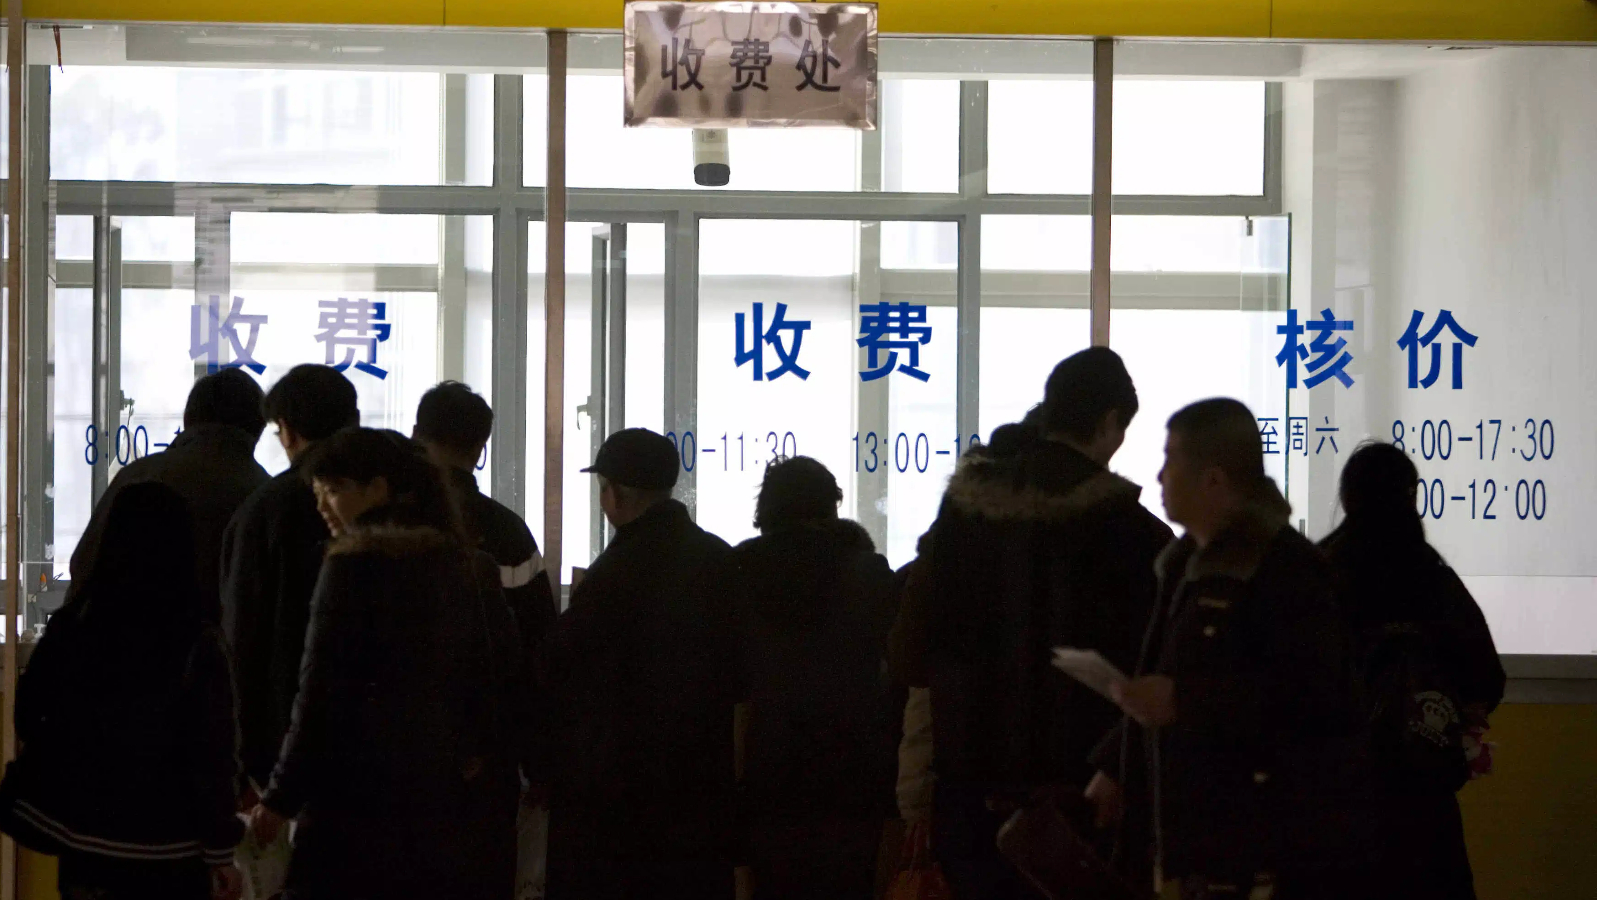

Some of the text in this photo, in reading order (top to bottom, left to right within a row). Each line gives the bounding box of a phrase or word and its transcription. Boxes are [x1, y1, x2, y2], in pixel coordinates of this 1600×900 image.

[661, 37, 842, 93] 收费处
[188, 295, 392, 381] 收费
[733, 301, 933, 383] 收费
[1275, 308, 1479, 390] 核价
[85, 424, 183, 466] 8:00-
[1256, 416, 1555, 462] 至周六 8:00-17:30
